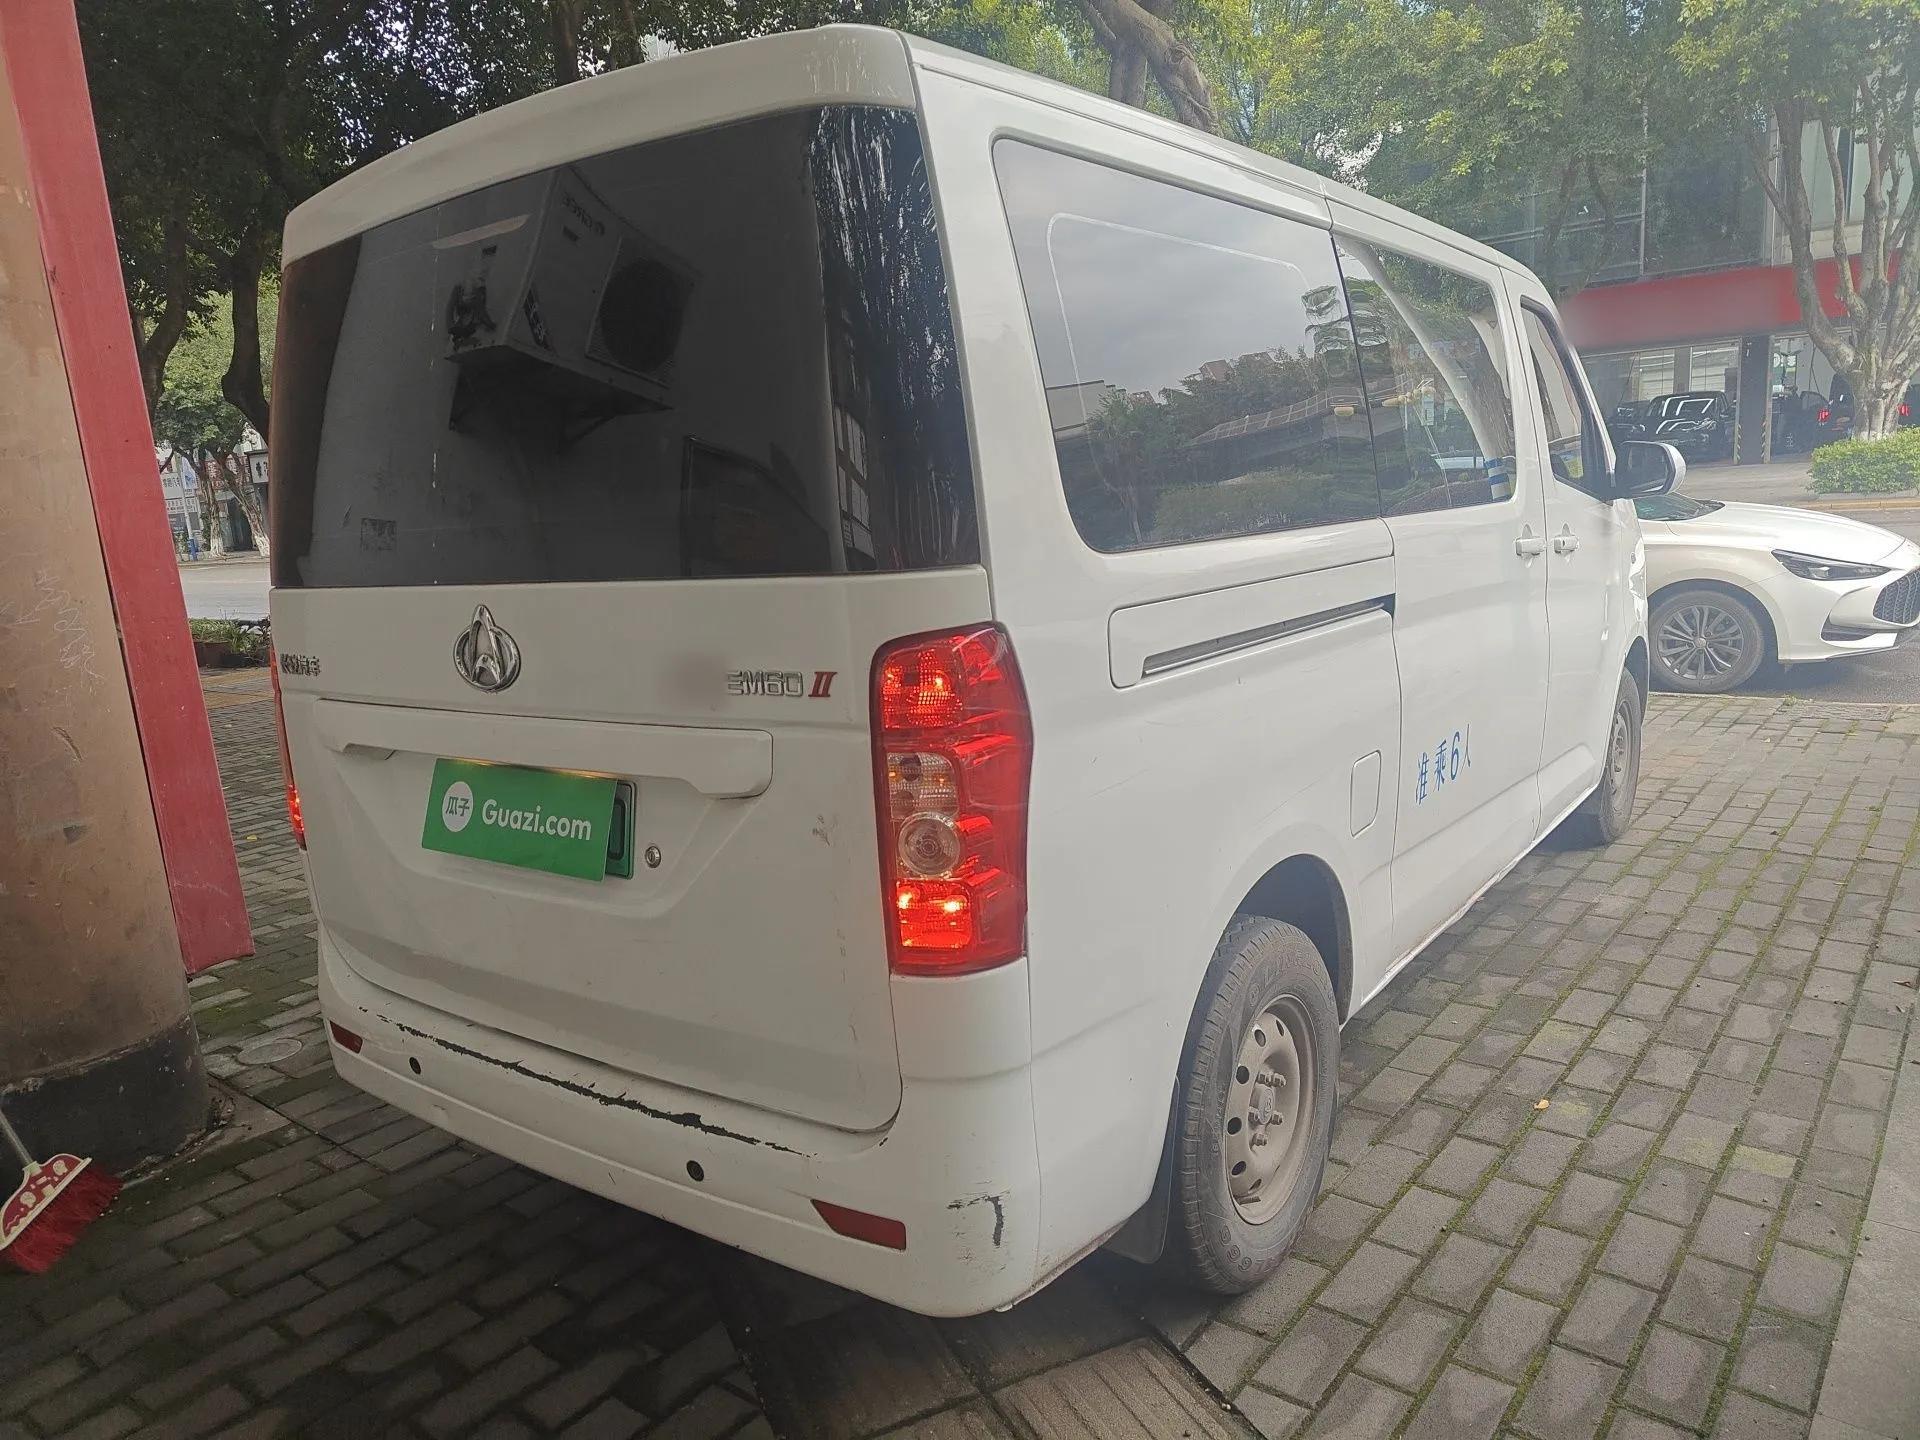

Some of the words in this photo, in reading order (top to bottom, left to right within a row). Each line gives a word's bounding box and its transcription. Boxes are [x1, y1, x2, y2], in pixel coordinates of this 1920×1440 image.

[727, 670, 804, 697] EM60
[1415, 723, 1471, 806] 准乘6人
[445, 796, 471, 817] 瓜子
[482, 799, 592, 841] Guazi.com
